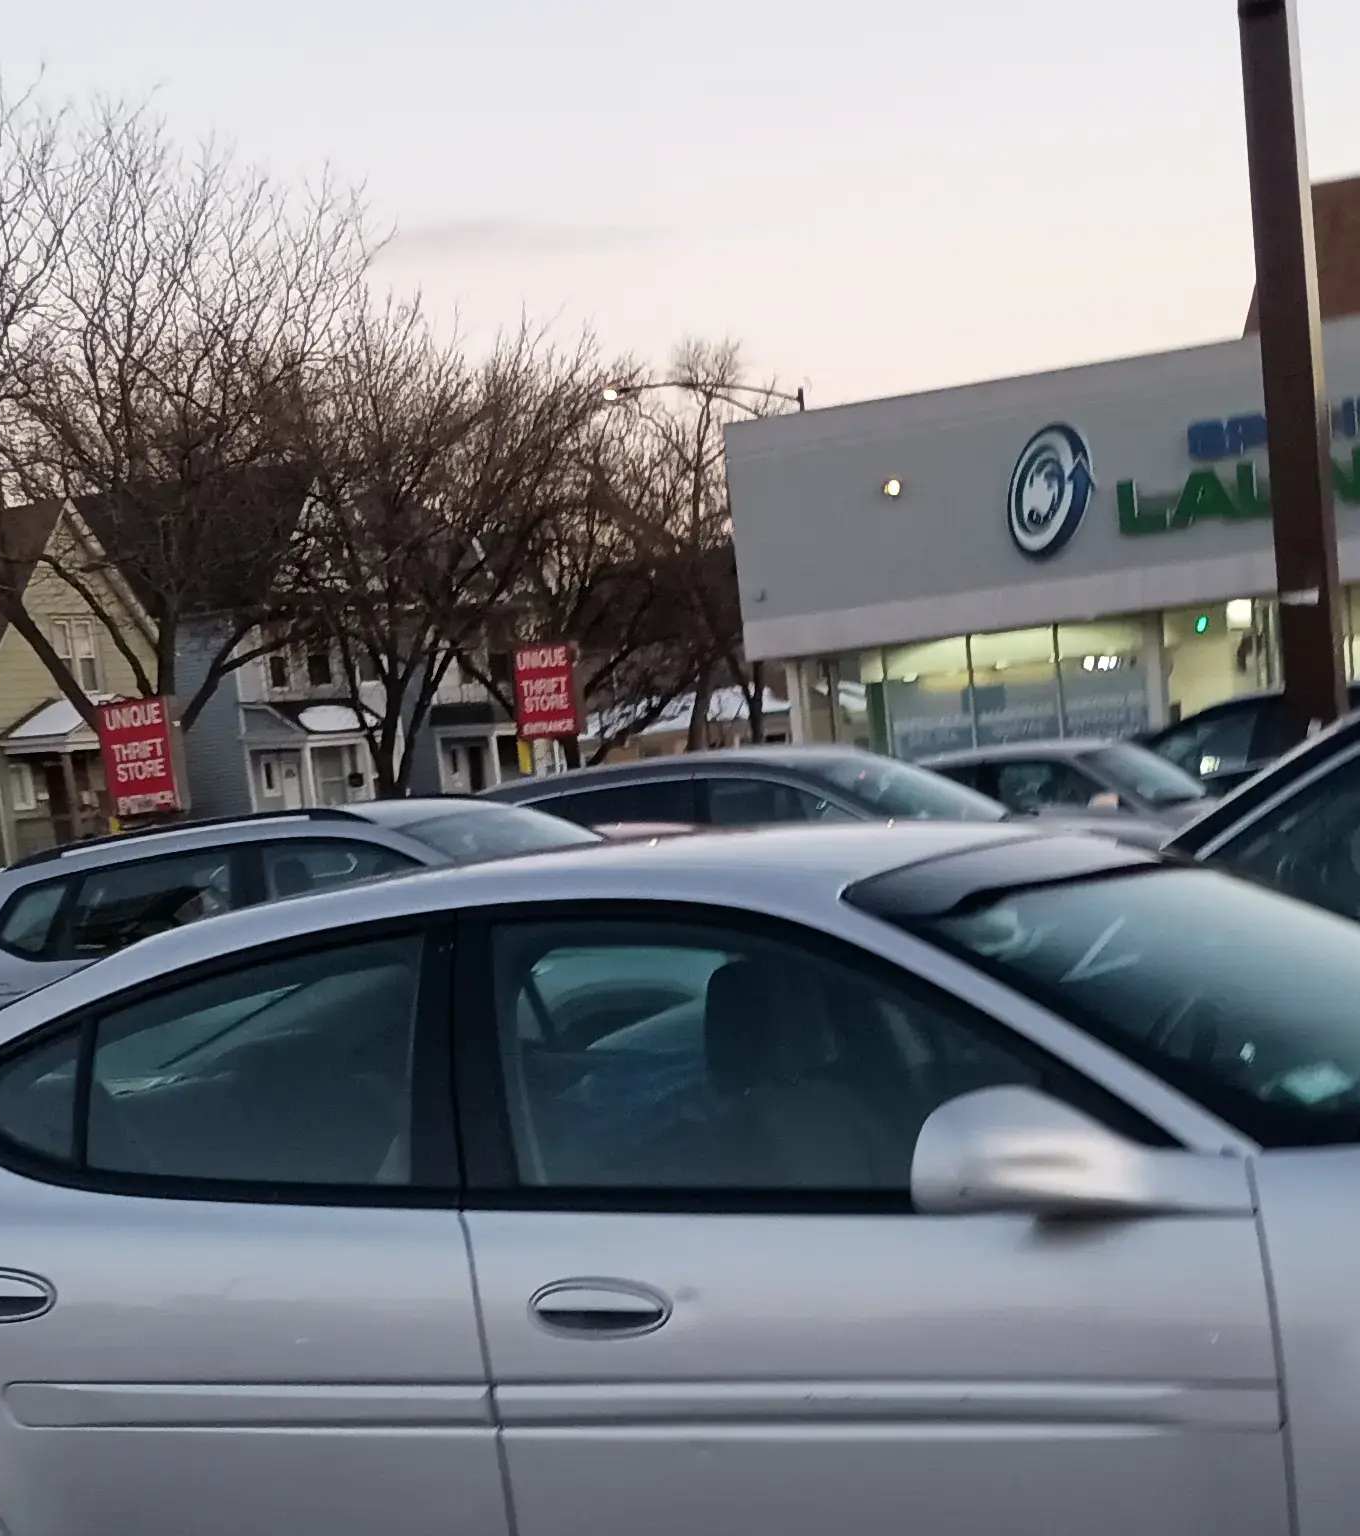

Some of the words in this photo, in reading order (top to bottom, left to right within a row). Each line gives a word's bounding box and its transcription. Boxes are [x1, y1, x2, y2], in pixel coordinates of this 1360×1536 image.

[516, 646, 567, 671] UNIQUE
[520, 676, 567, 697] THRIFT
[524, 692, 570, 714] STORE
[104, 703, 162, 731] UNIQUE
[111, 738, 164, 763] THRIFT
[116, 758, 166, 782] STORE
